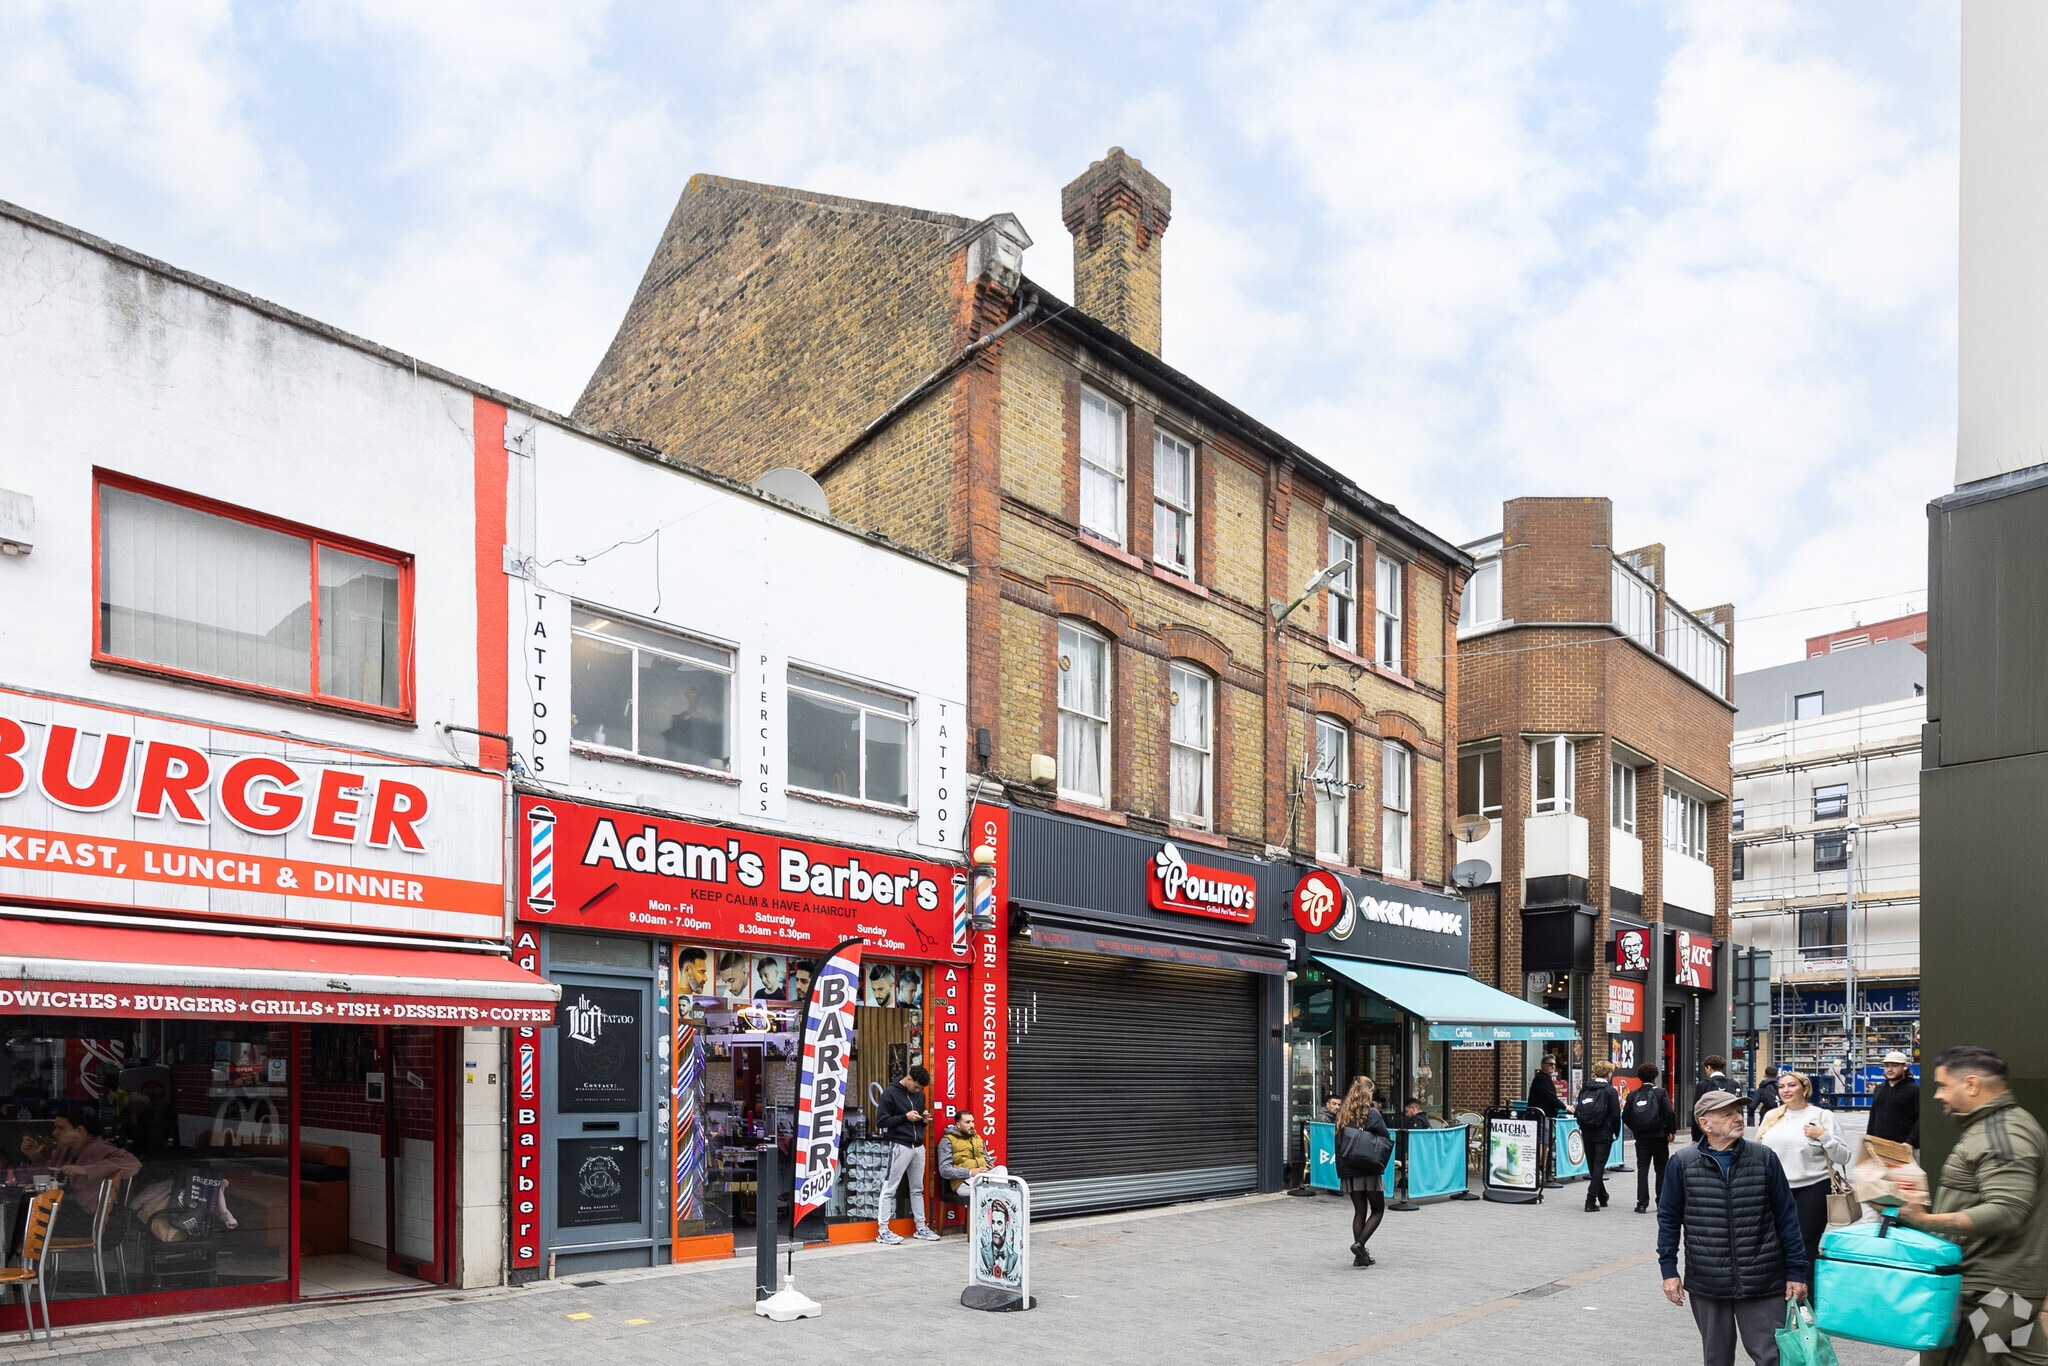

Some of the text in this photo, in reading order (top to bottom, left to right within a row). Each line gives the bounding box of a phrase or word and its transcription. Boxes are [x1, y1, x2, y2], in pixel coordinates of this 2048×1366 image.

[533, 593, 547, 772] TATTOOS
[760, 655, 768, 811] PIERCINGS
[938, 703, 947, 842] TATTOOS
[144, 850, 261, 885] LUNCH
[276, 866, 299, 889] &
[314, 870, 424, 902] DINNER
[581, 817, 766, 888] Adam's
[779, 846, 938, 910] Barber's
[649, 899, 670, 912] Mon
[680, 902, 693, 914] Fri
[691, 888, 858, 918] KEEP CALM & HAVE A HAIRCUT
[629, 911, 667, 926] 9.00am
[675, 916, 711, 931] 7.00pm
[738, 922, 771, 937] 8.30am
[779, 928, 811, 941] 6.30pm
[755, 911, 796, 927] Saturday
[857, 923, 887, 937] Sunday
[877, 938, 905, 951] 4.30pm
[984, 934, 996, 968] PERI
[1691, 944, 1713, 967] KFC
[133, 994, 237, 1014] BURGERS
[251, 999, 323, 1016] GRILLS
[337, 1002, 381, 1018] FISH
[394, 1004, 479, 1020] DESSERTS
[490, 1007, 551, 1022] COFFEE
[602, 1013, 634, 1024] TATTOO
[944, 968, 959, 1050] Adams
[983, 983, 996, 1061] BURGERS
[1455, 1028, 1473, 1038] Coffee
[802, 976, 847, 1202] BARBER SHOP
[983, 1074, 996, 1136] WRAPS
[1490, 1123, 1527, 1135] MATCHA
[518, 1108, 536, 1259] Barbers
